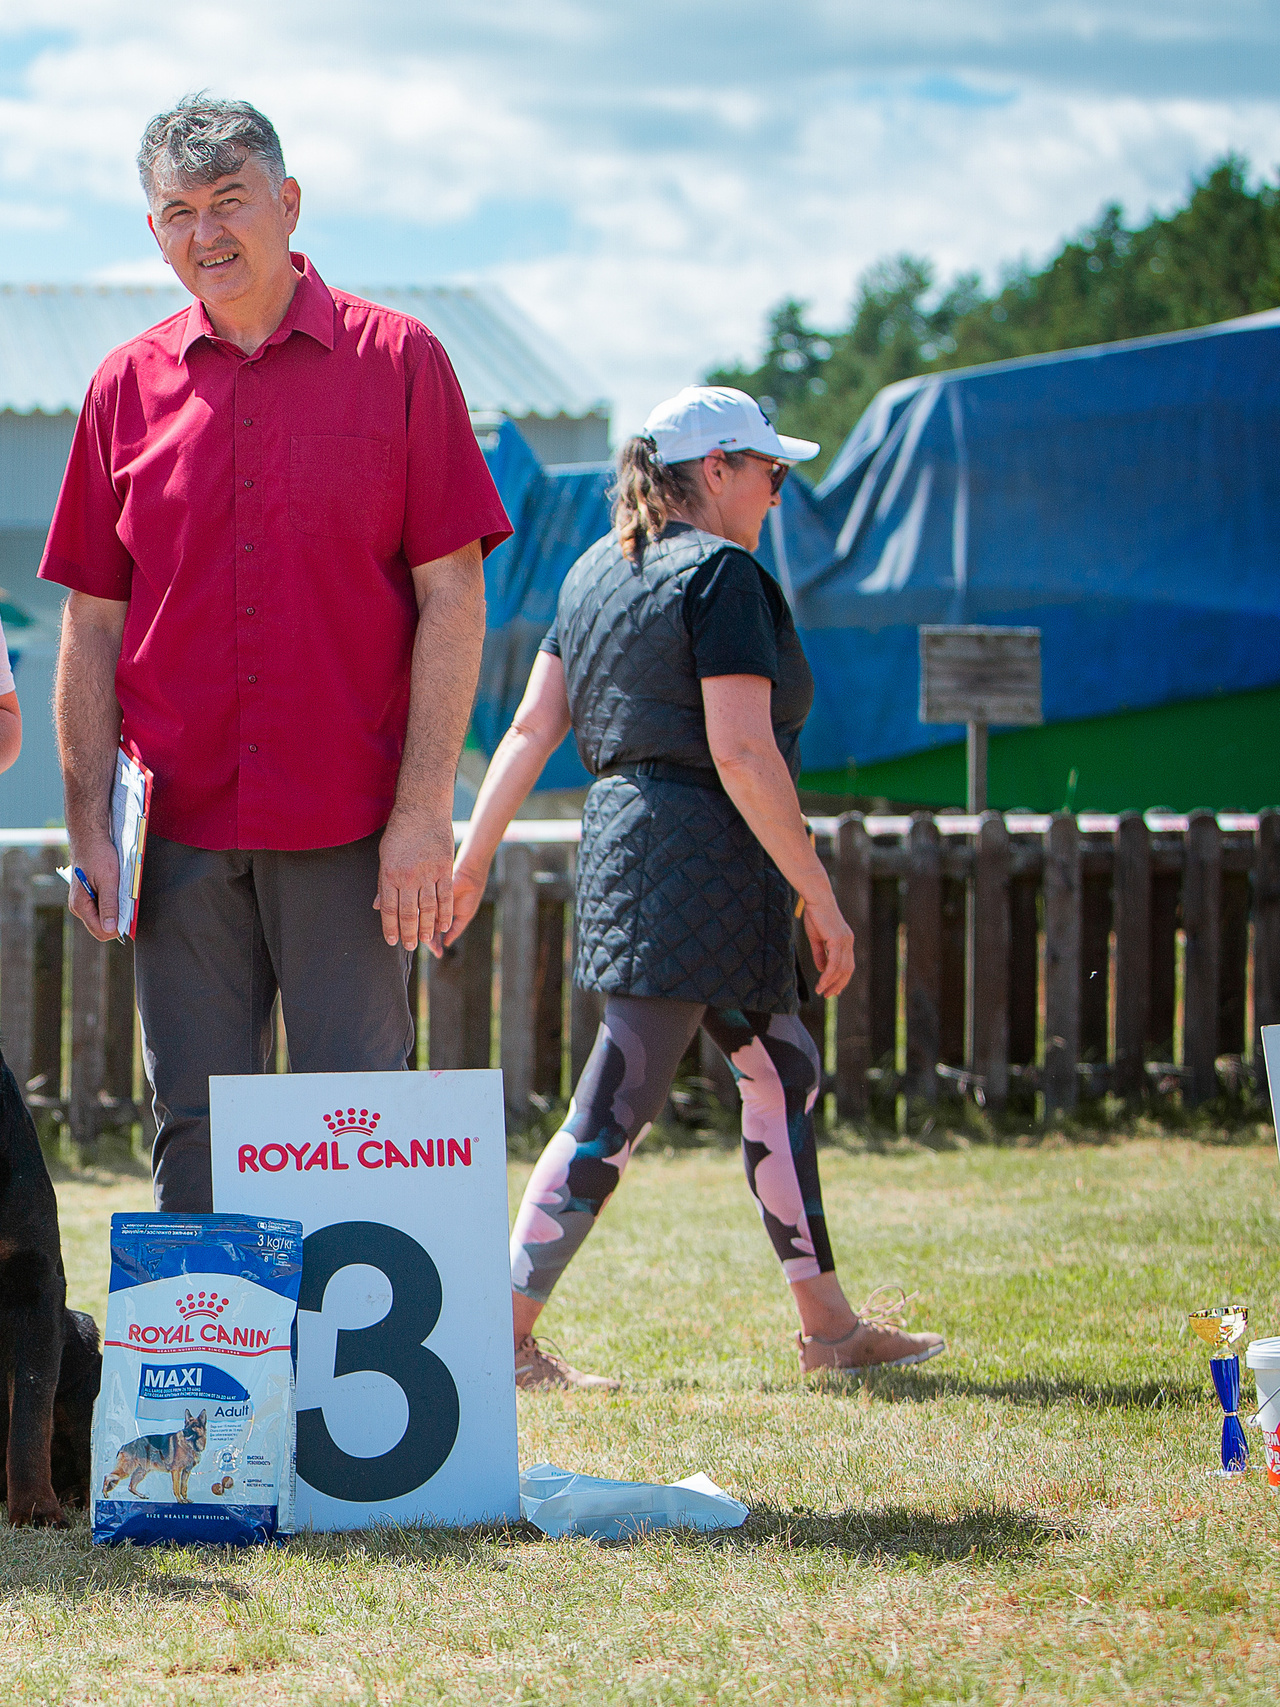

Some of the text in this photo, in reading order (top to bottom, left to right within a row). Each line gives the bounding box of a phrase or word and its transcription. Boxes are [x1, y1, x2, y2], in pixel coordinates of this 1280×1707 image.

[237, 1141, 349, 1173] ROYAL
[257, 1234, 264, 1246] 3
[128, 1323, 194, 1344] ROYAL
[296, 1220, 460, 1503] 3
[144, 1368, 202, 1388] MAXI
[214, 1405, 249, 1417] Adult
